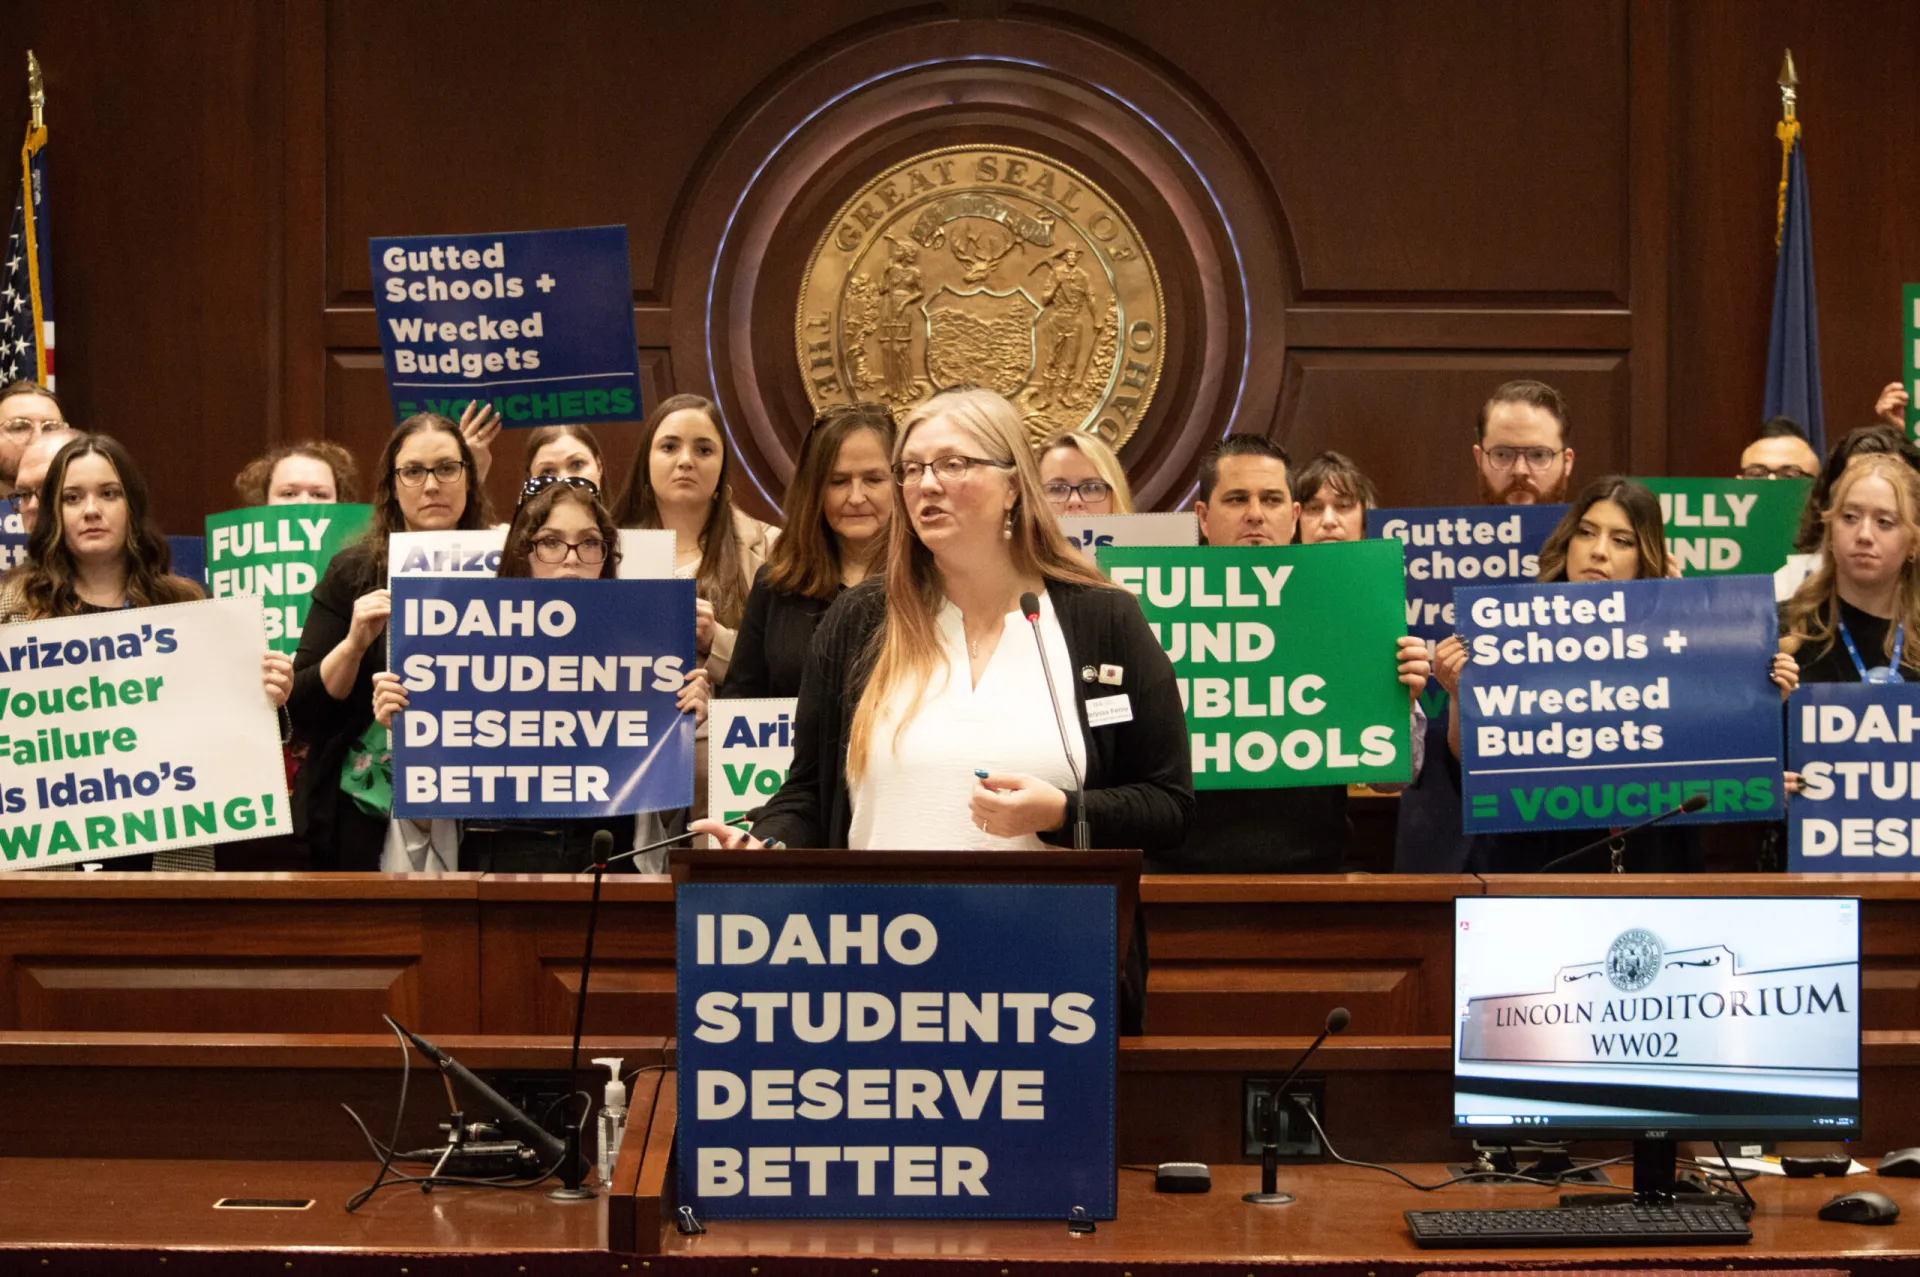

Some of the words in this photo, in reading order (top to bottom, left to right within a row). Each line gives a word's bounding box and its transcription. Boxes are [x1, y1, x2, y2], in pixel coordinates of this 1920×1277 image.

[835, 159, 956, 253] GREAT
[975, 155, 1082, 213] SEAL
[383, 242, 505, 272] Gutted
[385, 273, 524, 303] Schools
[388, 312, 544, 342] Wrecked
[395, 347, 540, 378] Budgets
[1092, 320, 1154, 446] DAHO
[212, 519, 331, 561] FULLY
[1382, 515, 1521, 547] Gutted
[400, 543, 504, 573] Arizo
[1403, 549, 1541, 580] chools
[212, 562, 317, 599] FUND
[404, 599, 576, 638] IDAHO
[1471, 591, 1626, 628] Gutted
[1148, 622, 1275, 663] UND
[1472, 628, 1649, 666] Schools
[402, 654, 685, 692] STUDENTS
[1176, 674, 1327, 718] BLIC
[1473, 677, 1670, 717] Wrecked
[404, 709, 649, 747] DESERVE
[1477, 720, 1664, 759] Budgets
[1802, 704, 1920, 743] IDAH
[1191, 725, 1396, 773] HOOLS
[36, 761, 196, 809] Idaho's
[405, 765, 610, 803] BETTER
[1509, 776, 1775, 822] VOUCHERS
[0, 793, 277, 861] WARNING!
[696, 913, 938, 966] IDAHO
[693, 991, 1096, 1045] STUDENTS
[1496, 1001, 1593, 1027] LINCOLN
[1601, 982, 1851, 1023] AUDITORIUM
[1591, 1032, 1680, 1058] WW02
[696, 1068, 1045, 1121] DESERVE
[696, 1146, 990, 1198] BETTER
